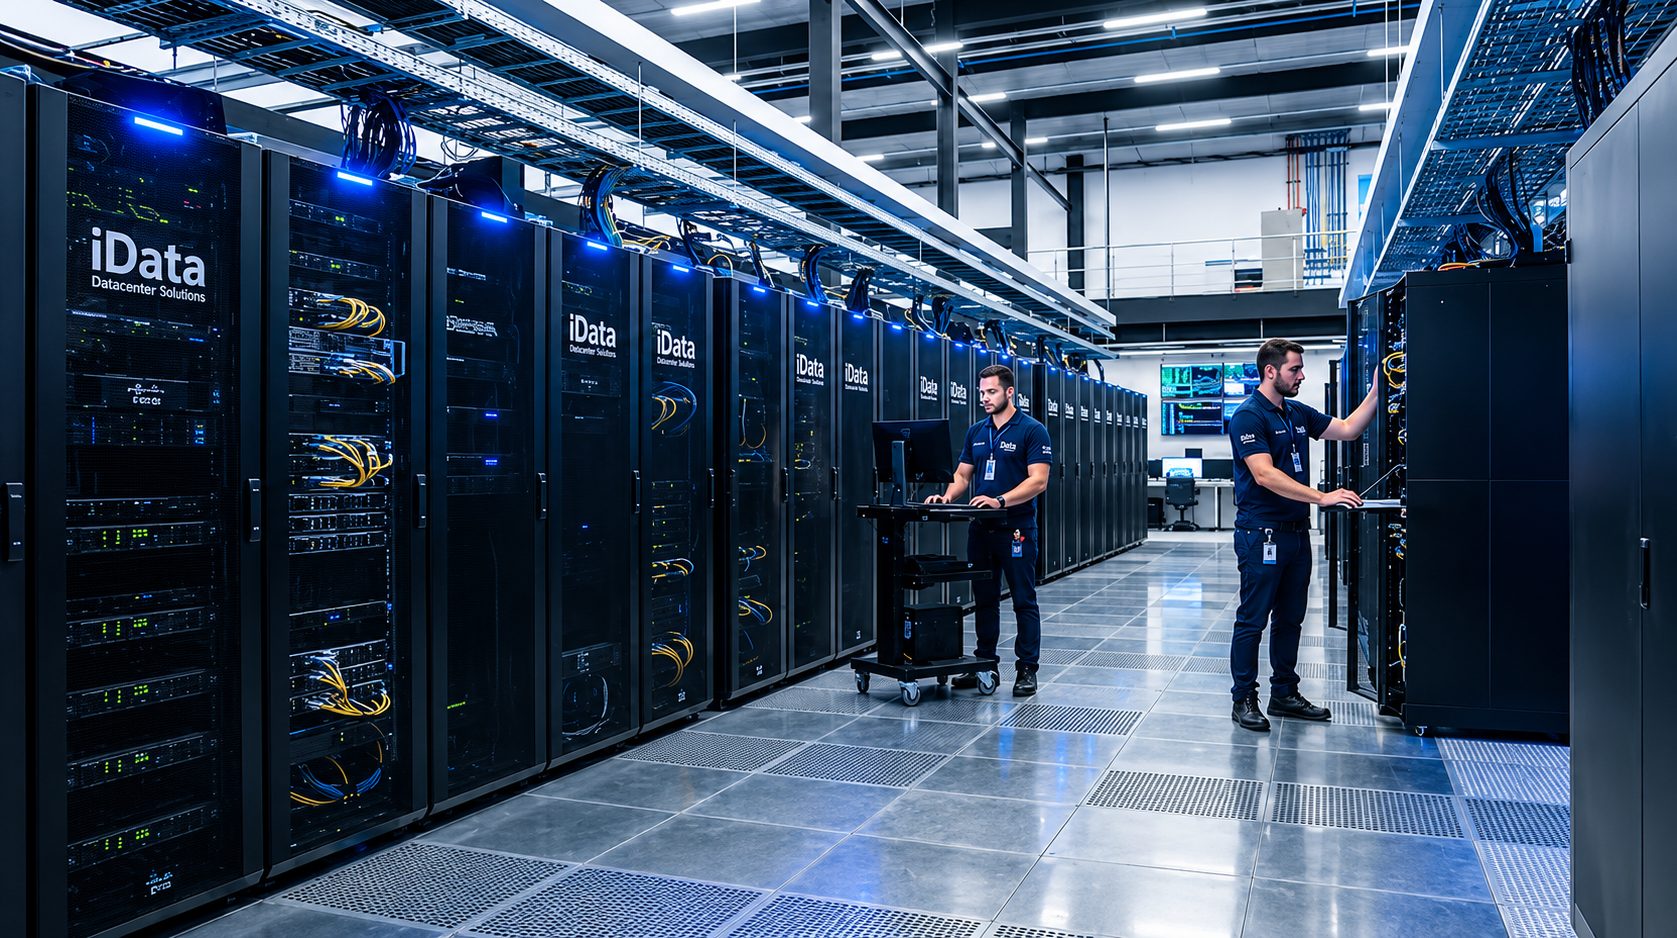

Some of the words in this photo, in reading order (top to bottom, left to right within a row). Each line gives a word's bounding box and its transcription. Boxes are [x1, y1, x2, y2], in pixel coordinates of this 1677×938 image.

[91, 226, 206, 287] iData
[91, 274, 157, 296] Datacenter
[160, 285, 206, 303] Solutions
[569, 312, 616, 348] iData
[657, 328, 696, 360] iData
[796, 352, 824, 379] iData
[844, 362, 869, 386] iData
